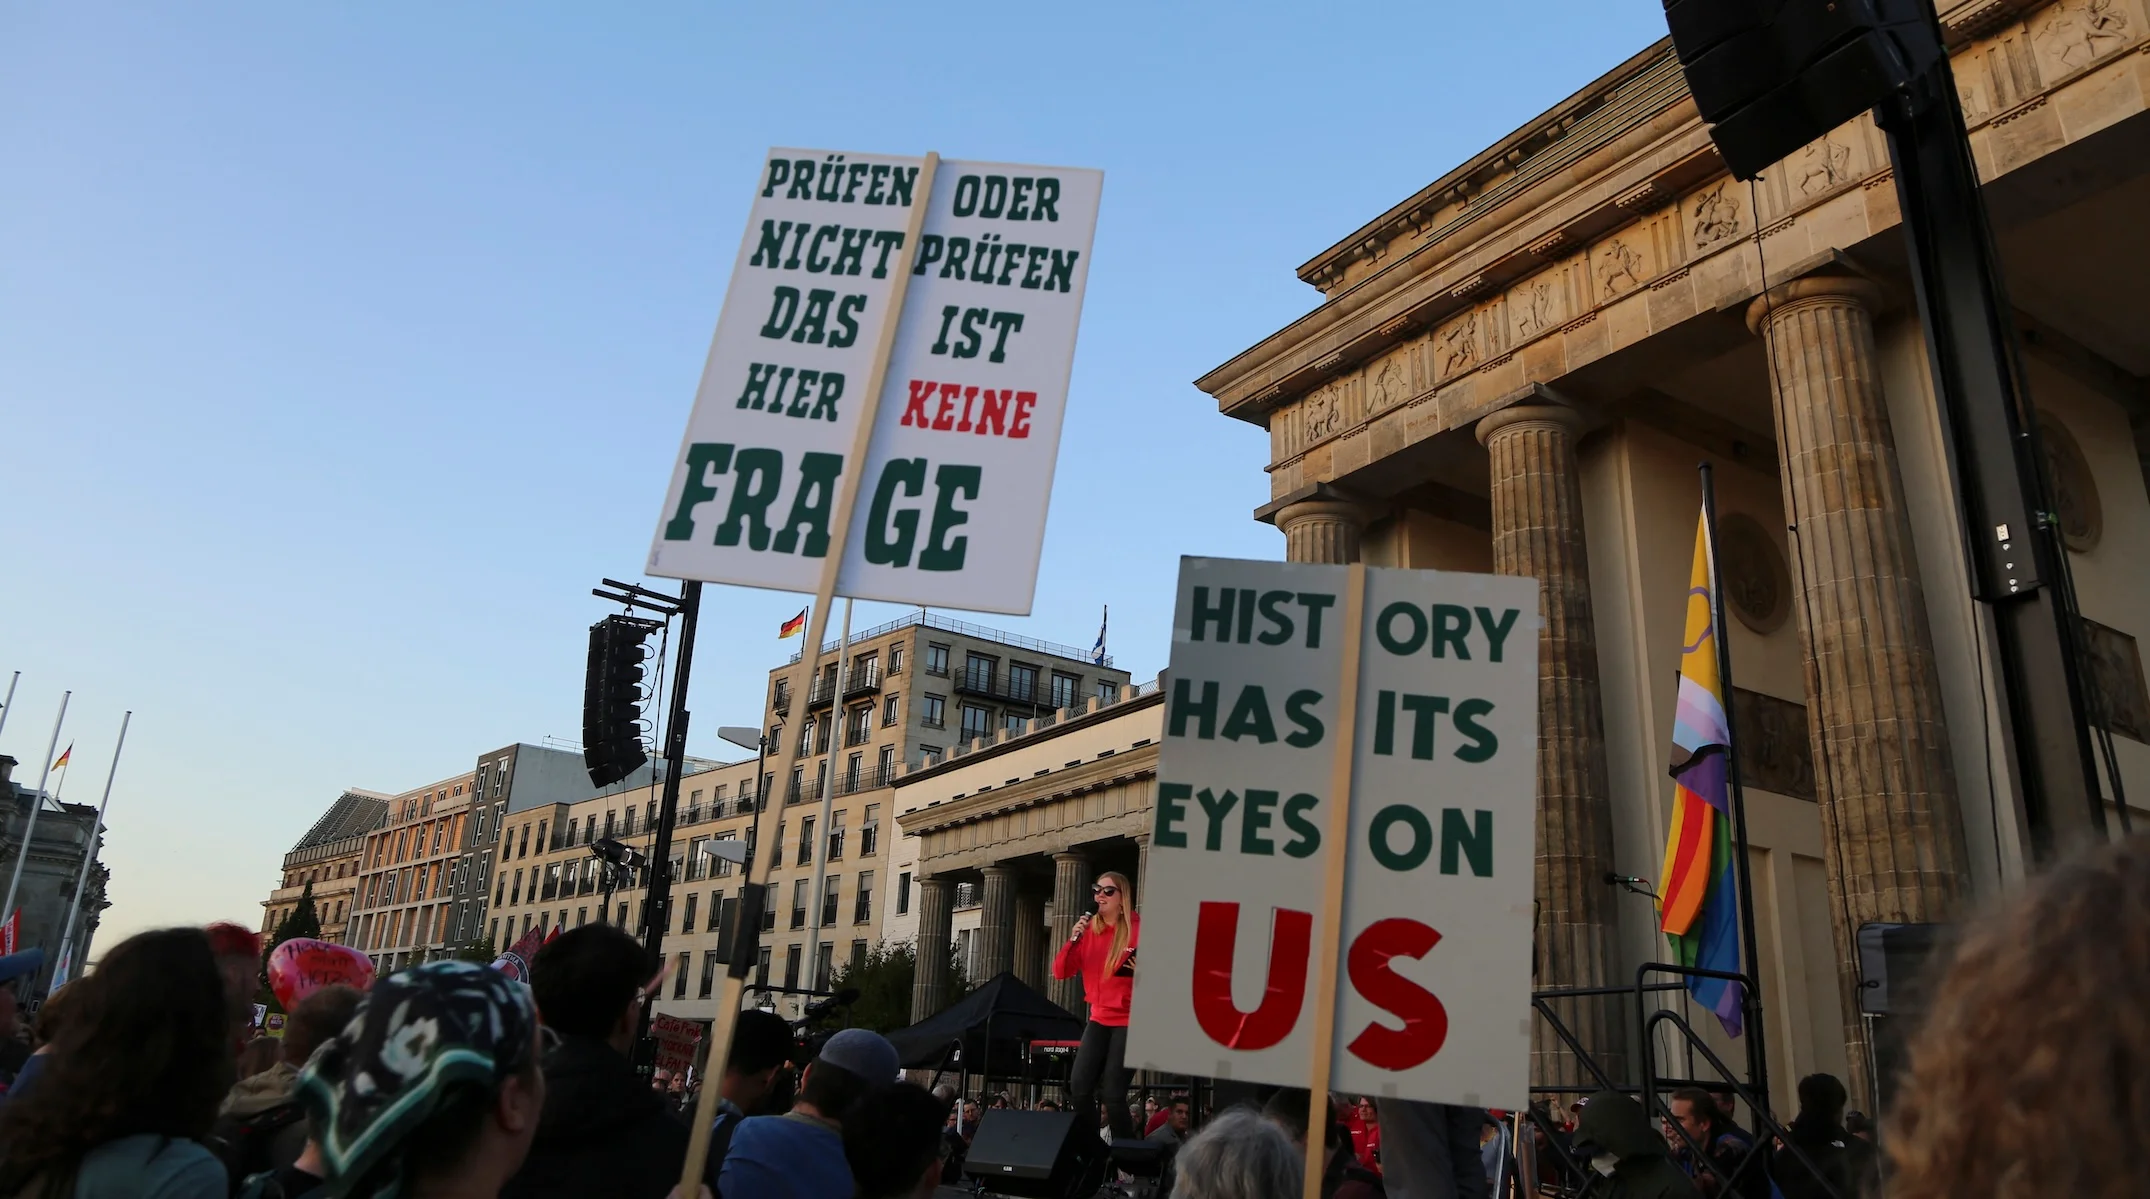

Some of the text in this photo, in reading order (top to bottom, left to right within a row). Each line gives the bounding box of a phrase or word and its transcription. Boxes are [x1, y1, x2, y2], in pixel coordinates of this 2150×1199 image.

[762, 154, 1060, 222] PRÜFEN ODER
[750, 219, 1079, 293] NICHT PRÜFEN
[760, 286, 1024, 364] DAS IST
[736, 362, 1037, 439] HIER KEINE
[1167, 677, 1499, 764] HAS ITS
[1153, 781, 1494, 878] EYES ON
